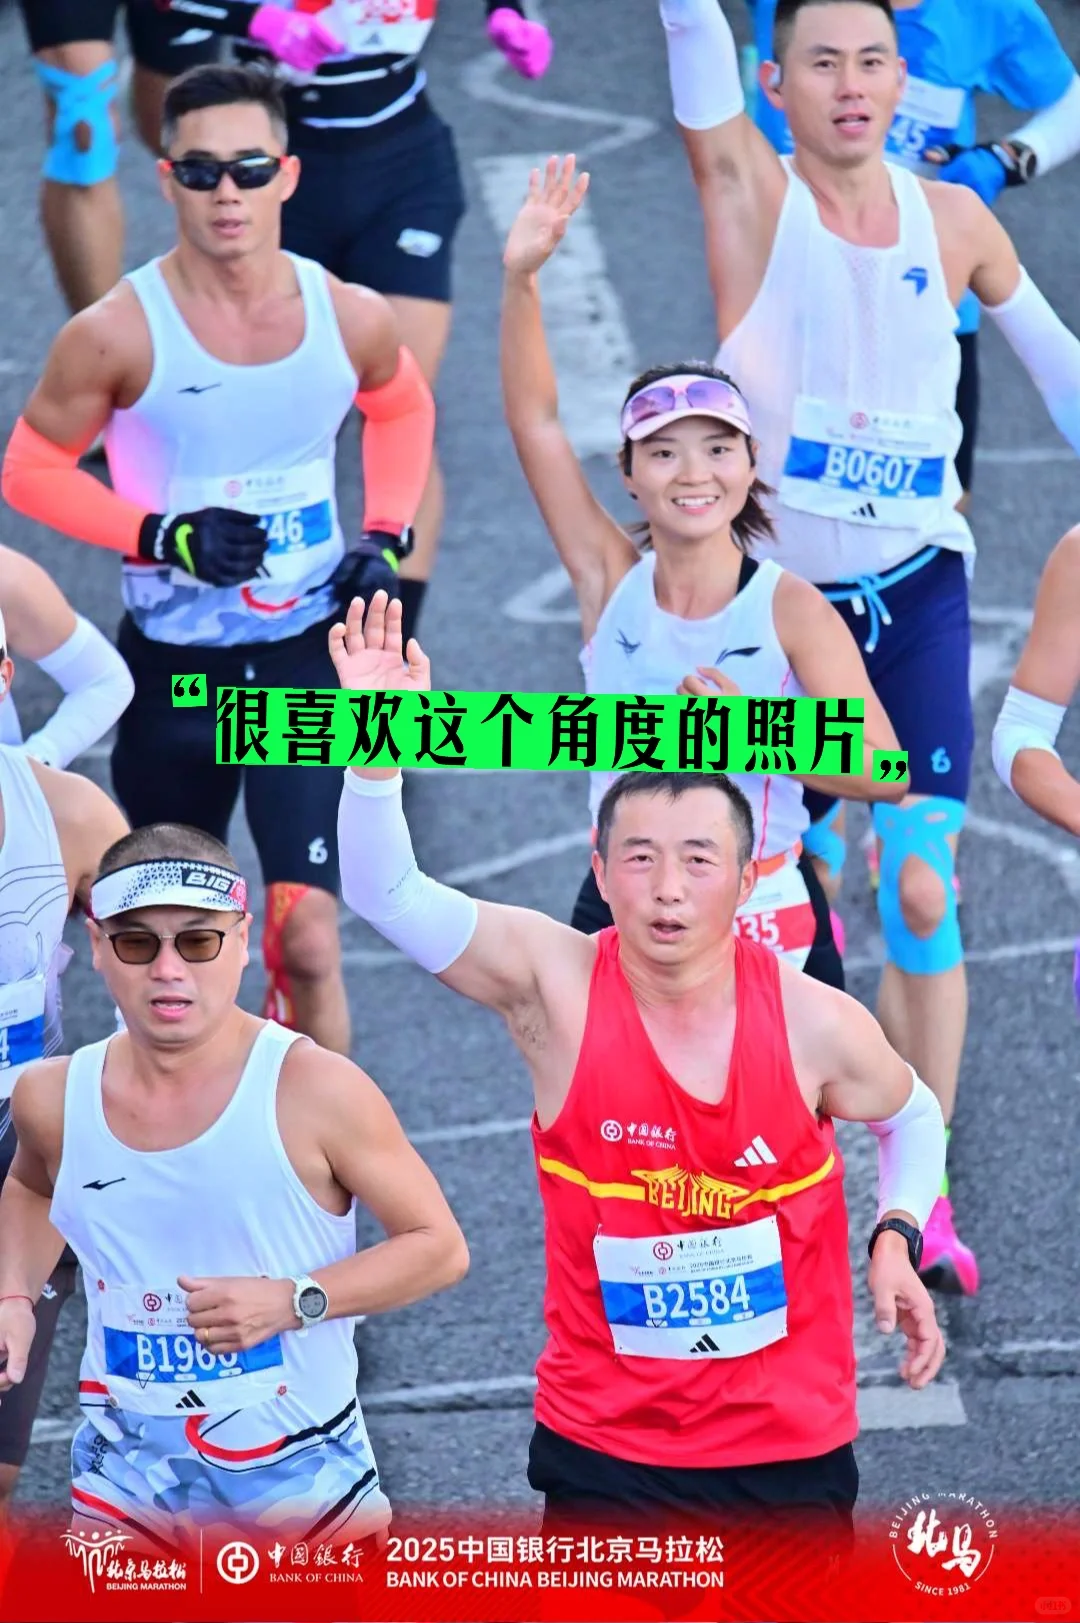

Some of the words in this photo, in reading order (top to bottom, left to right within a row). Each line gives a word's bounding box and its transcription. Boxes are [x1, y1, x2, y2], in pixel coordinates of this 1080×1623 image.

[824, 445, 922, 490] B0607
[261, 510, 303, 545] 46
[185, 871, 232, 893] BIG
[640, 1168, 740, 1219] BEIJING
[642, 1274, 751, 1319] B2584
